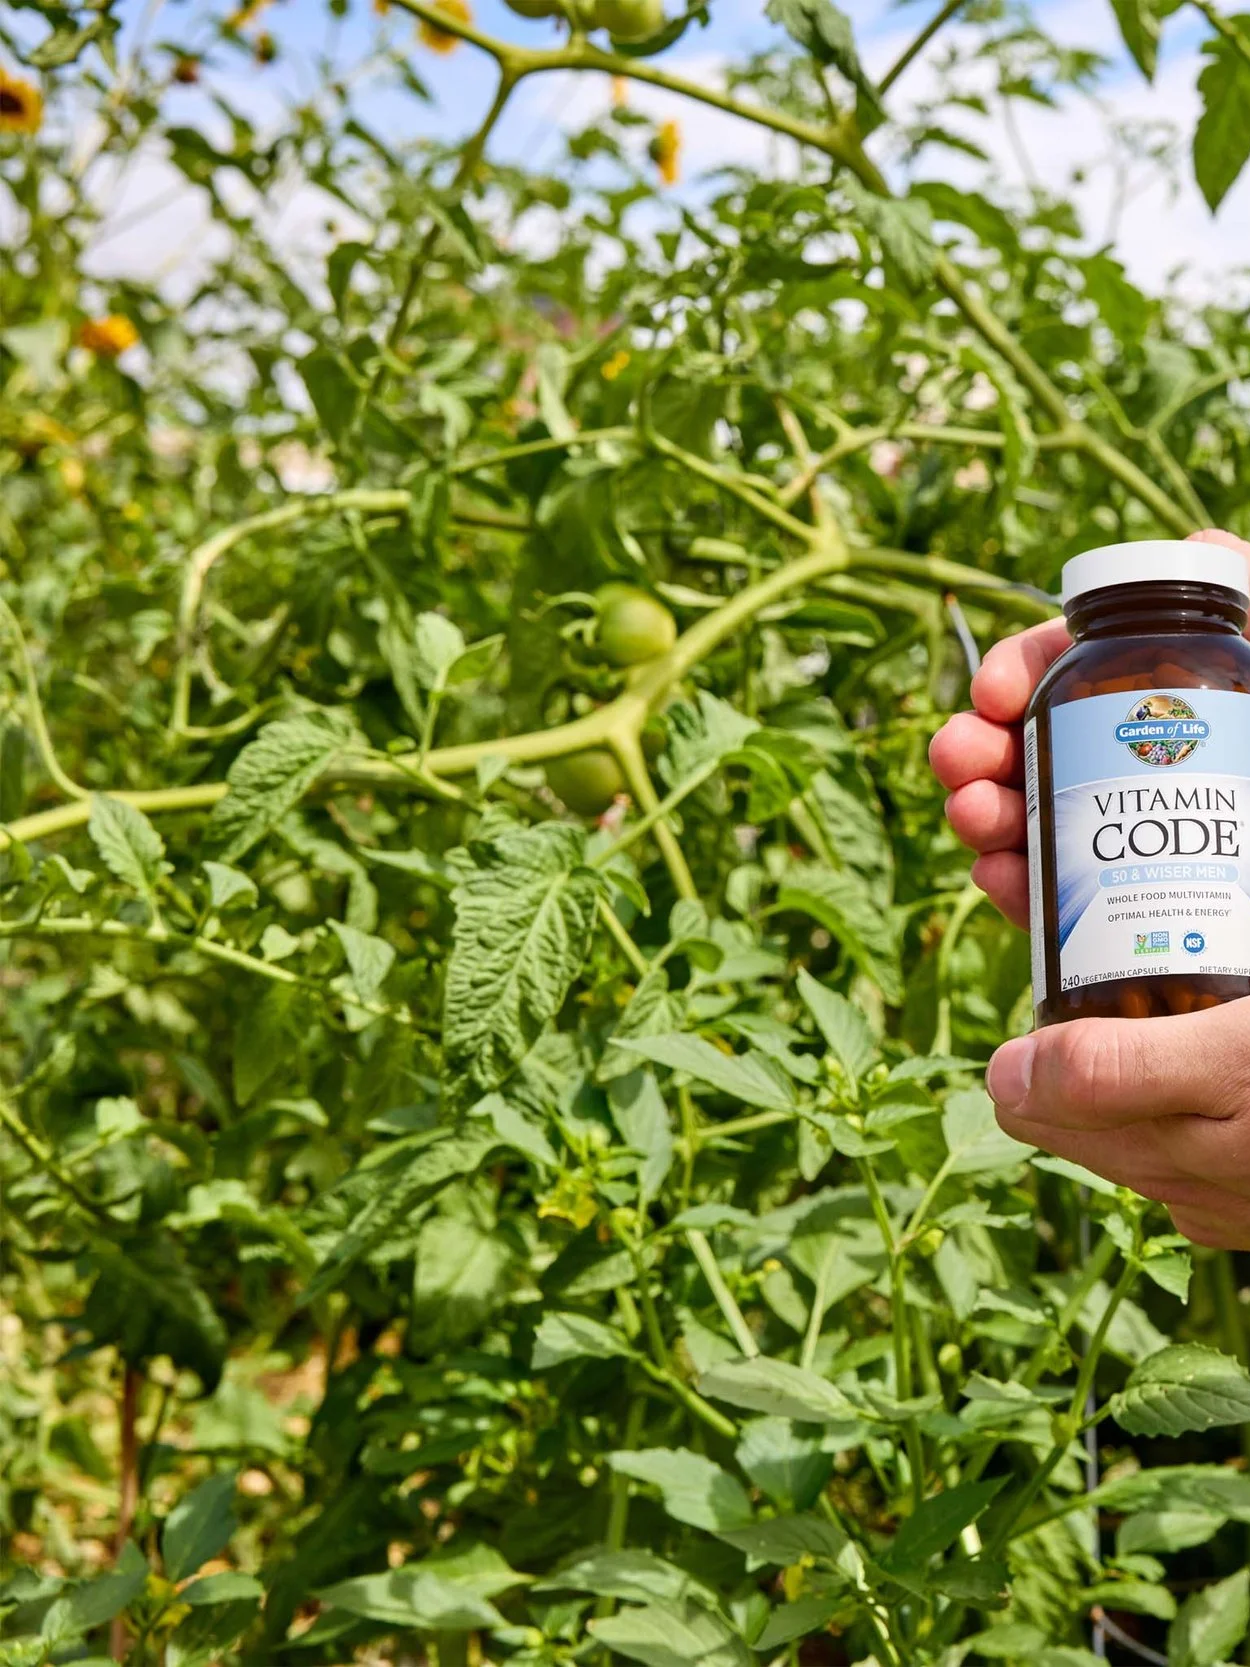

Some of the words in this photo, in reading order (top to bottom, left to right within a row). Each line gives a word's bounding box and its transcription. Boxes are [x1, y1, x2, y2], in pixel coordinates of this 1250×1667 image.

[1119, 724, 1164, 737] Garden
[1167, 721, 1181, 737] of
[1183, 723, 1206, 735] Life
[1093, 787, 1236, 816] VITAMIN
[1092, 818, 1240, 861] CODE
[1112, 870, 1127, 883] 50
[1131, 868, 1141, 881] &
[1145, 865, 1192, 879] WISER
[1196, 866, 1226, 879] MEN
[1107, 893, 1138, 905] WHOLE
[1141, 891, 1167, 901] FOOD
[1169, 890, 1232, 900] MULTIVITAMIN
[1108, 911, 1146, 922] OPTIMAL
[1149, 909, 1184, 918] HEALTH
[1185, 908, 1192, 916] &
[1194, 908, 1230, 917] ENERGY
[1186, 937, 1202, 949] NSF
[1062, 974, 1080, 990] 240
[1080, 970, 1125, 984] VEGETARIAN
[1127, 966, 1169, 977] CAPSULES
[1199, 966, 1232, 974] DIETARY
